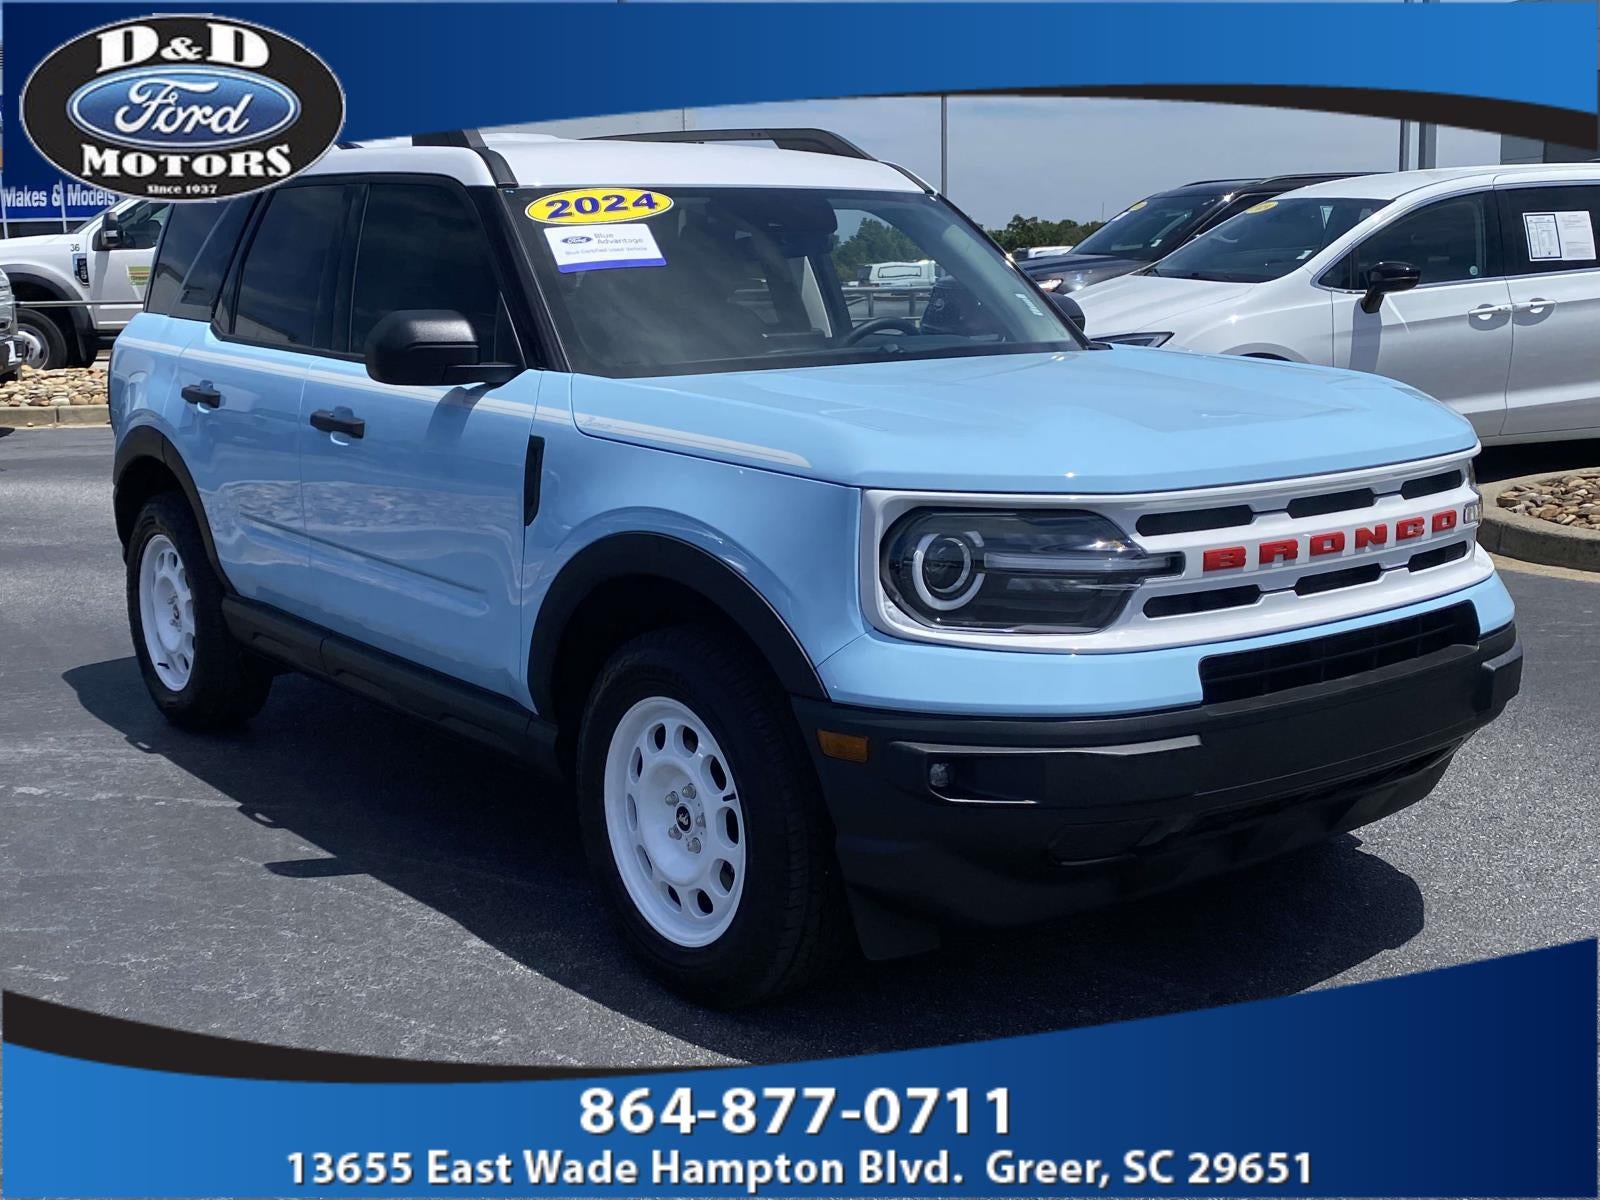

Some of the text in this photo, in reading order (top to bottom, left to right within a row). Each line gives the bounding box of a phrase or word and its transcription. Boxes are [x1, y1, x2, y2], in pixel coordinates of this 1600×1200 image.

[3, 184, 115, 208] Makes & Models
[546, 193, 658, 219] 2024
[70, 243, 80, 252] 36
[1202, 509, 1457, 572] BRONCO
